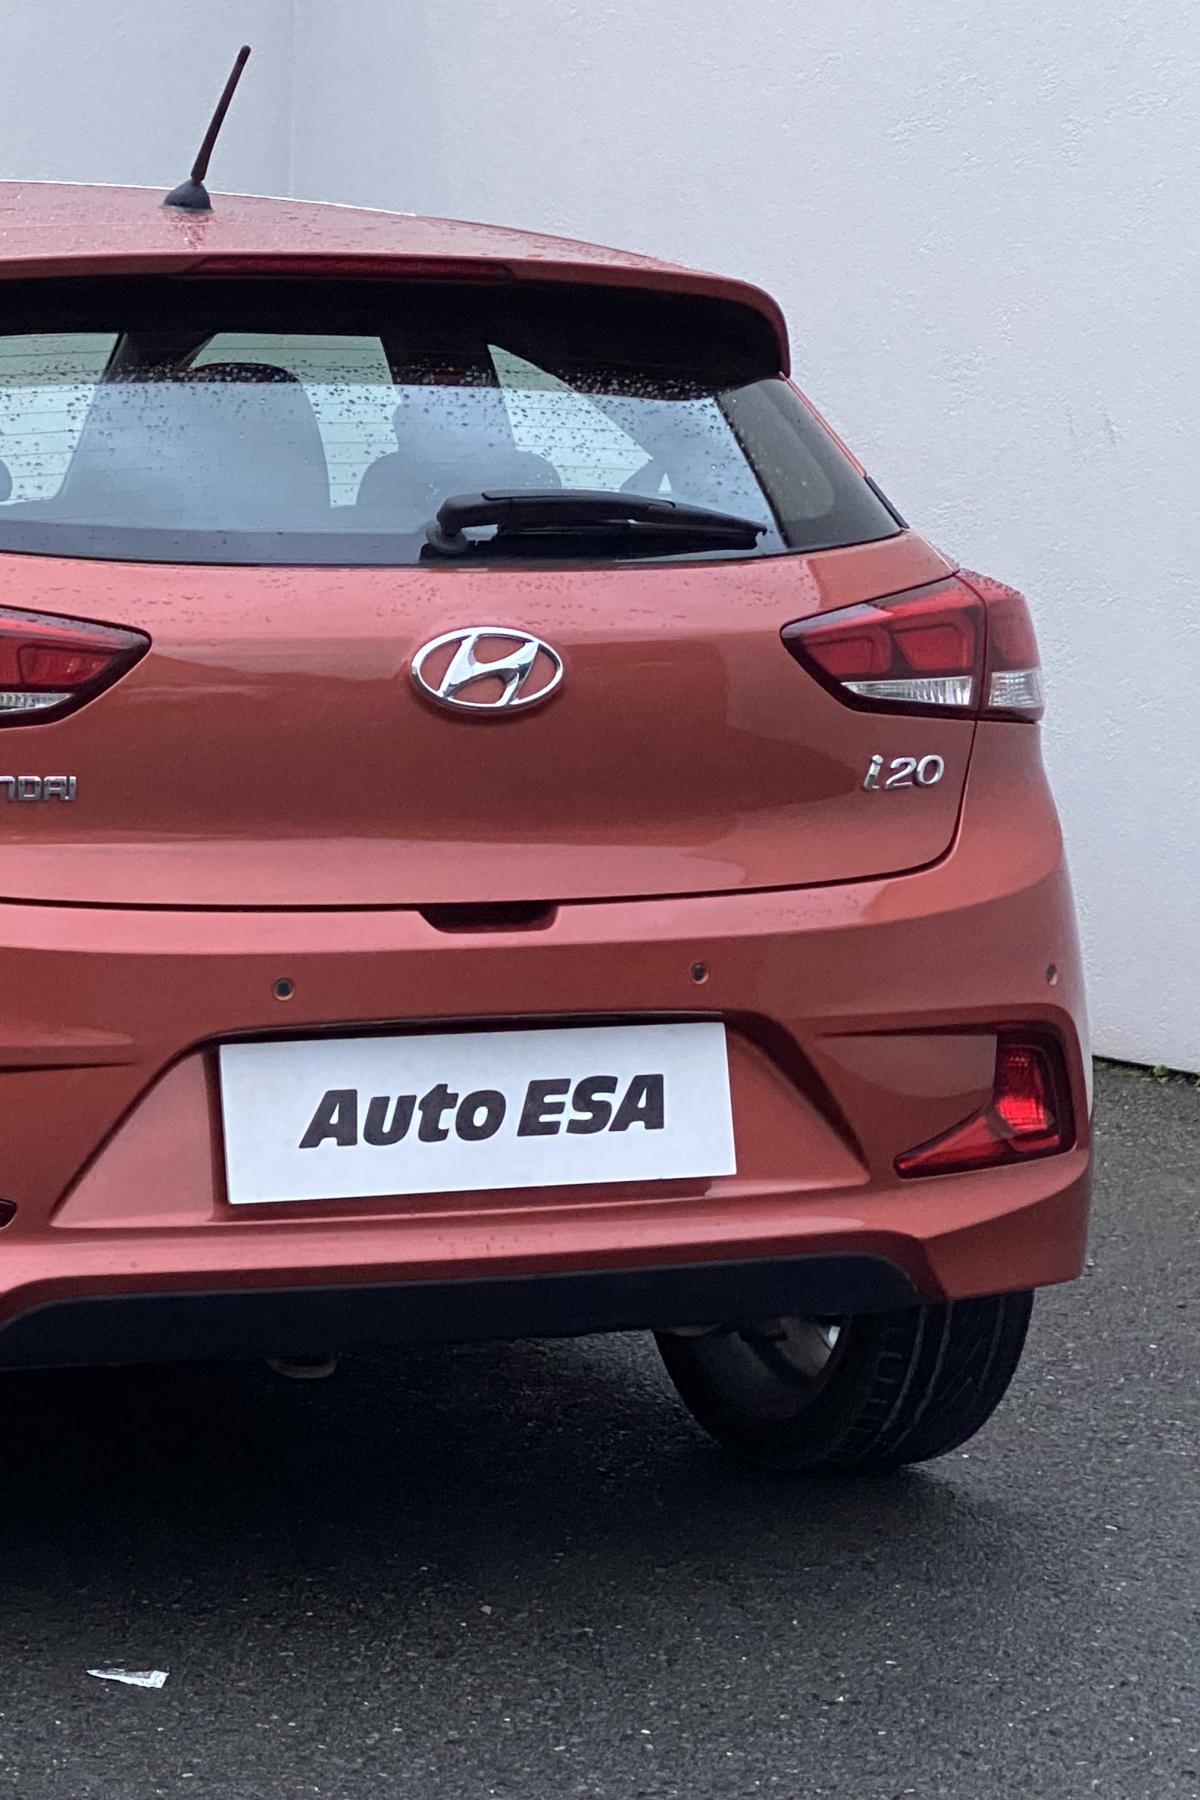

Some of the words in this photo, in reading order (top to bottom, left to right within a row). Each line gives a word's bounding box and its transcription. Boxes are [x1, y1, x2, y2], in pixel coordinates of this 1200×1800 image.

[863, 754, 945, 790] i20
[299, 1084, 507, 1149] Auto
[517, 1074, 664, 1137] ESA
